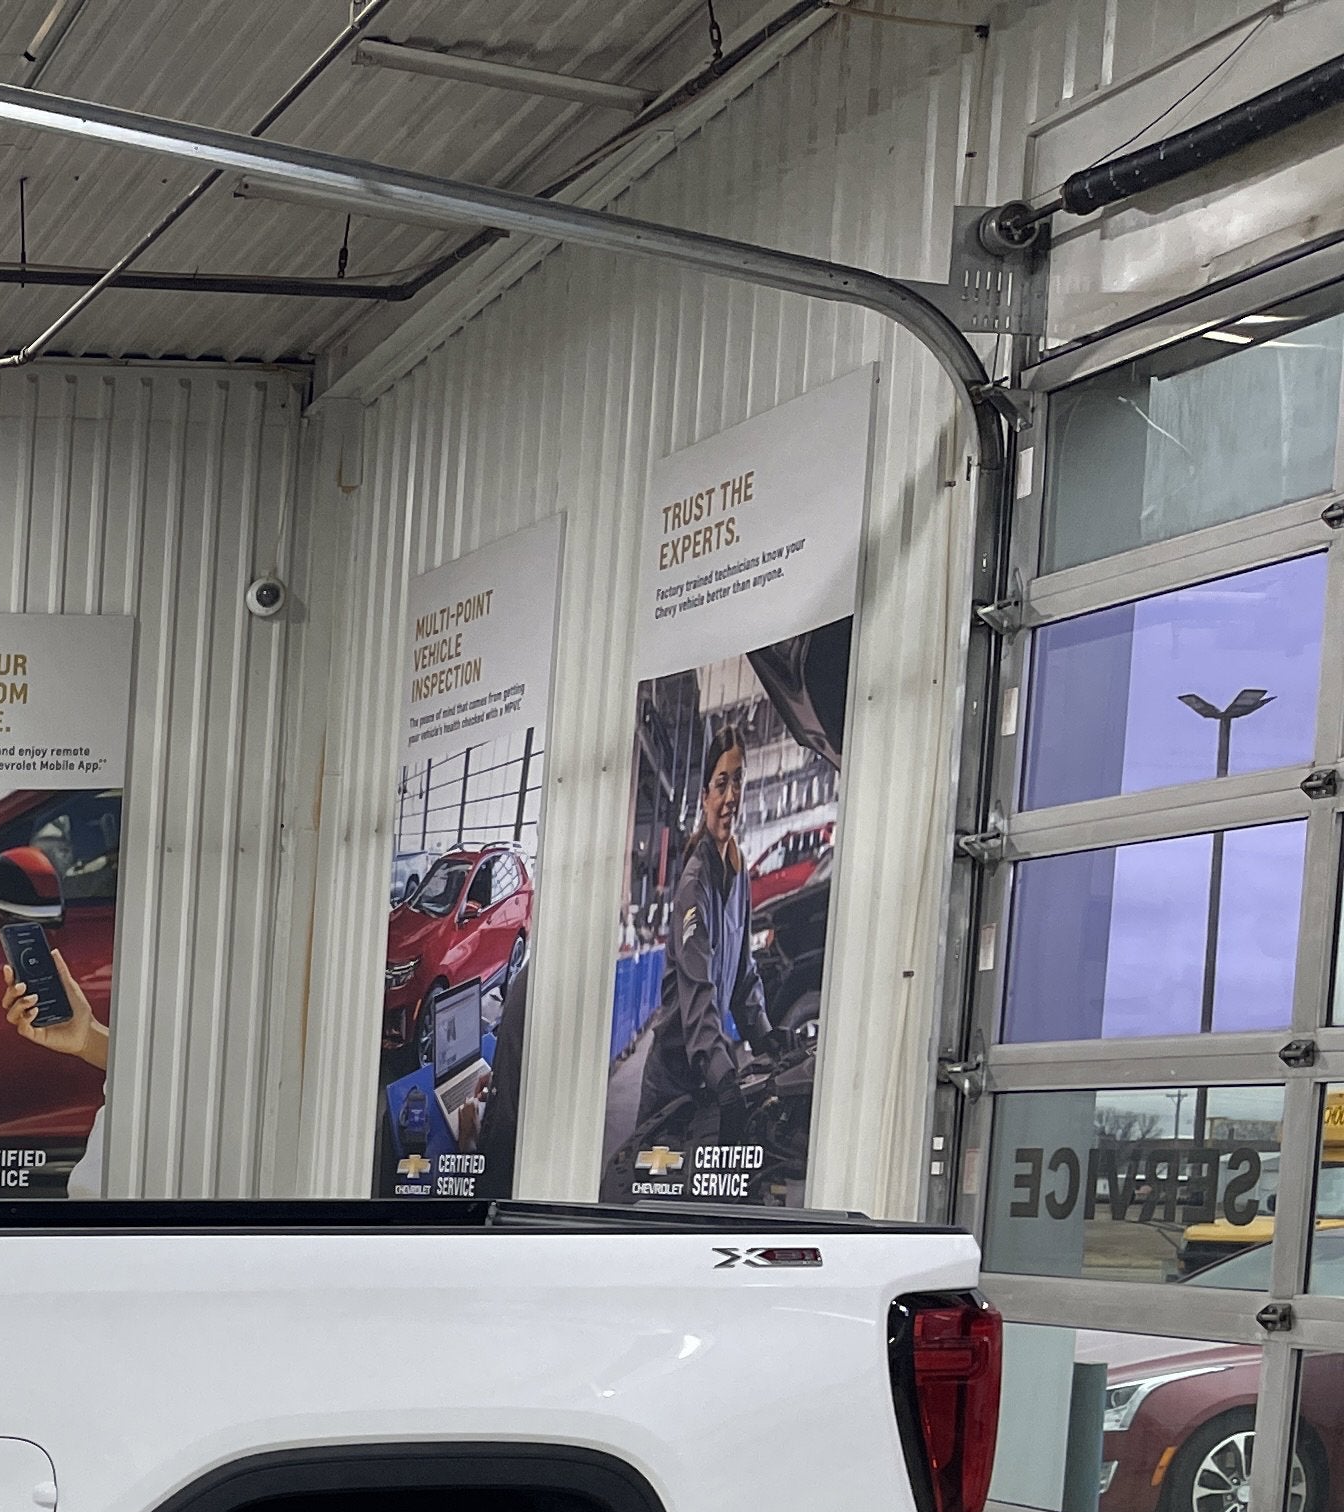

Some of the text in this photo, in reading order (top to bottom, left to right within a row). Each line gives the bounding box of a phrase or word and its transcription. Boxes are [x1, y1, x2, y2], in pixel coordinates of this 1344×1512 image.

[663, 471, 754, 534] TRUST THE
[660, 517, 739, 570] EXPERTS.
[656, 539, 805, 601] Factory trained technicians know your
[655, 567, 784, 619] Chevy vehicle better than anyone.
[416, 589, 493, 641] MULTI-POINT
[414, 633, 462, 672] VEHICLE
[412, 657, 481, 703] INSPECTION
[19, 746, 47, 759] enjoy
[51, 747, 90, 756] remote
[40, 761, 74, 770] Mobile
[439, 1155, 485, 1174] CERTIFIED
[695, 1146, 763, 1168] CERTIFIED
[395, 1185, 431, 1195] CHEVROLET
[437, 1177, 475, 1196] SERVICE
[632, 1183, 684, 1195] CHEVROLET
[692, 1174, 749, 1196] SERVICE
